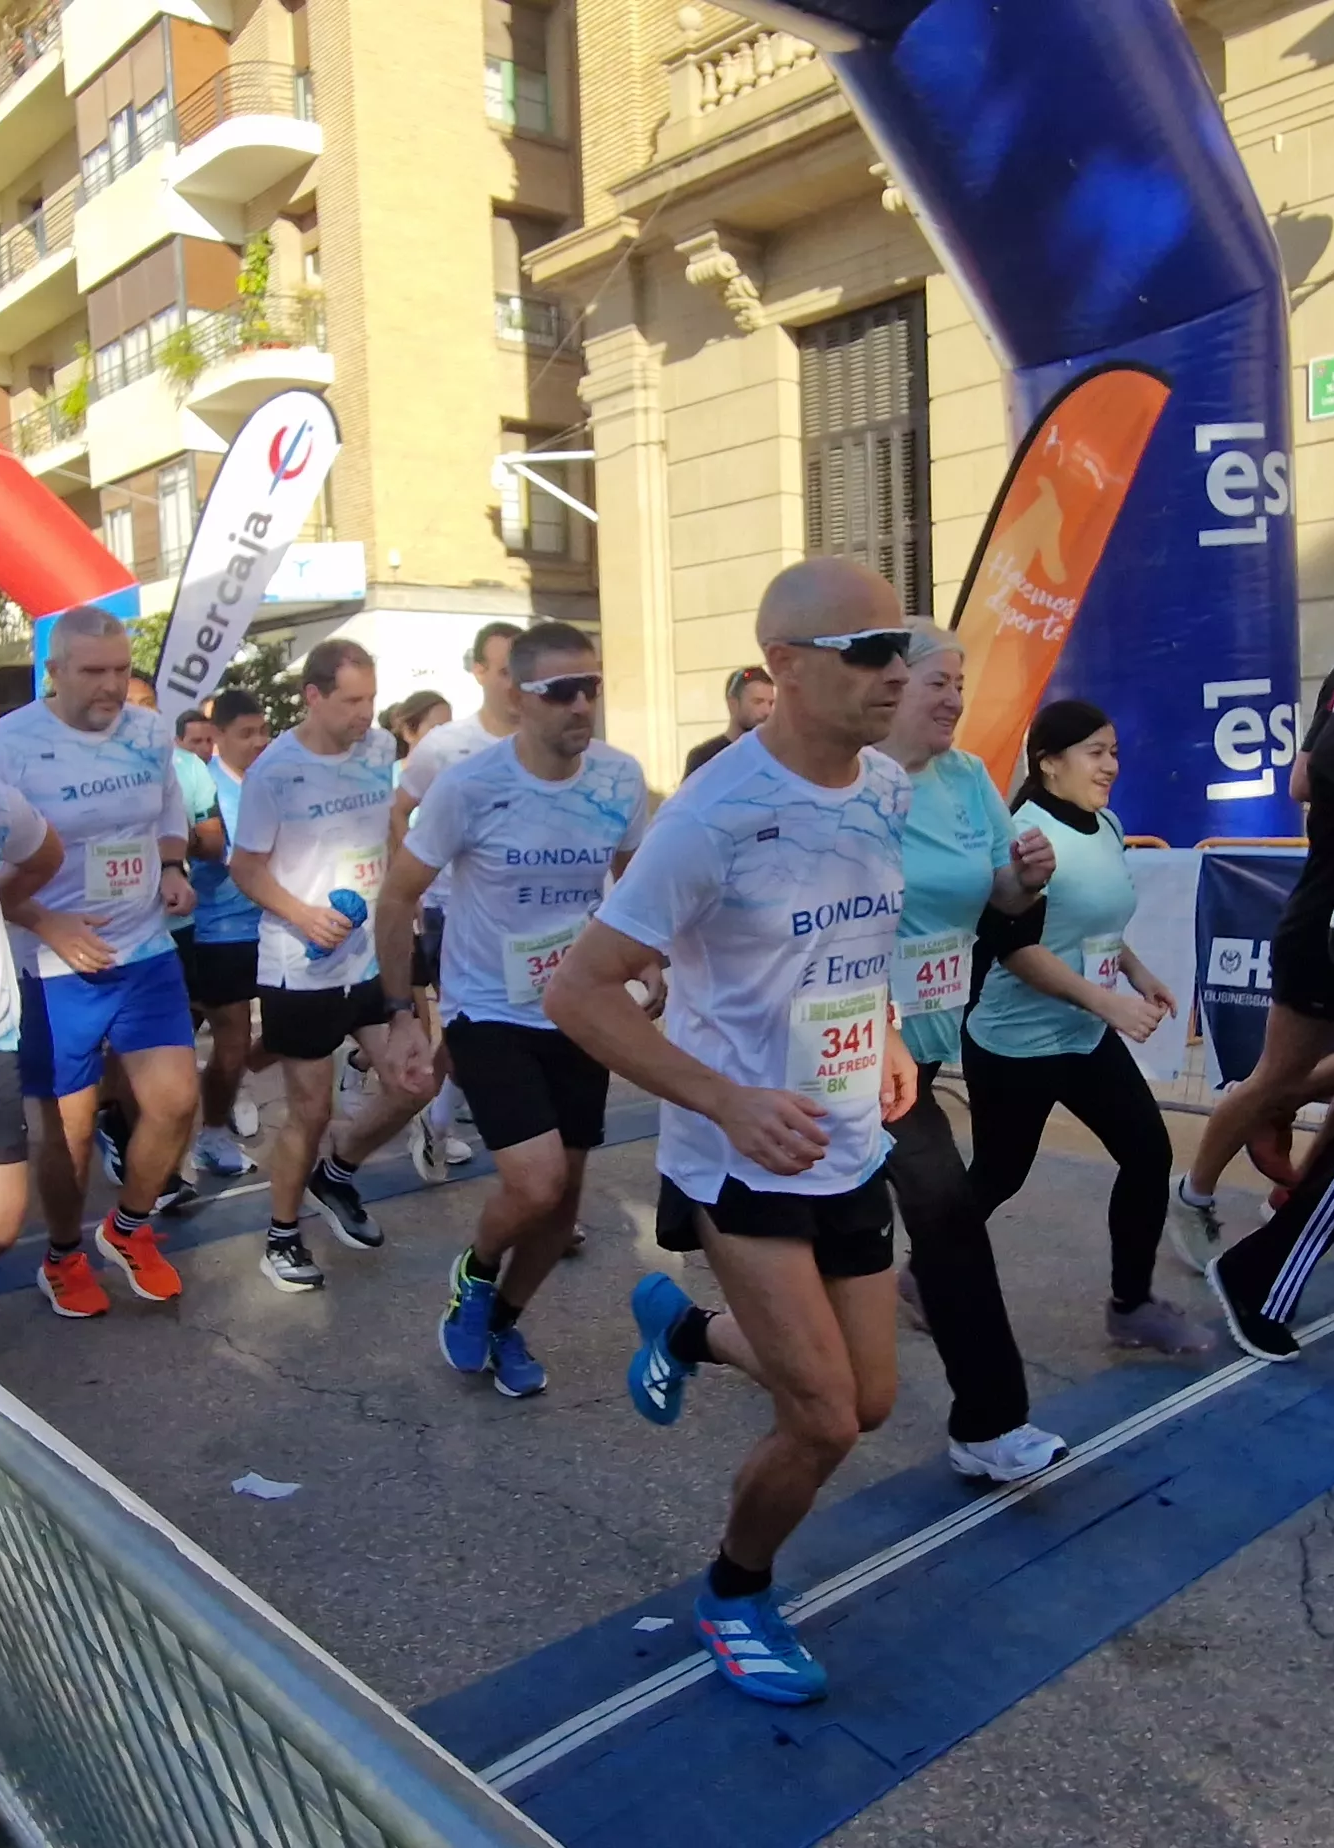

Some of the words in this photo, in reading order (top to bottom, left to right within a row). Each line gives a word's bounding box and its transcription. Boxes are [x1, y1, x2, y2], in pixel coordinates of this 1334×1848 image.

[167, 510, 273, 700] Ibercaja
[80, 770, 153, 798] COGITIAR
[105, 856, 144, 879] 310
[916, 954, 960, 985] 417
[918, 981, 964, 1000] MONTSE
[821, 1018, 875, 1059] 341
[817, 1053, 877, 1078] ALFREDO
[826, 1075, 848, 1094] 8K
